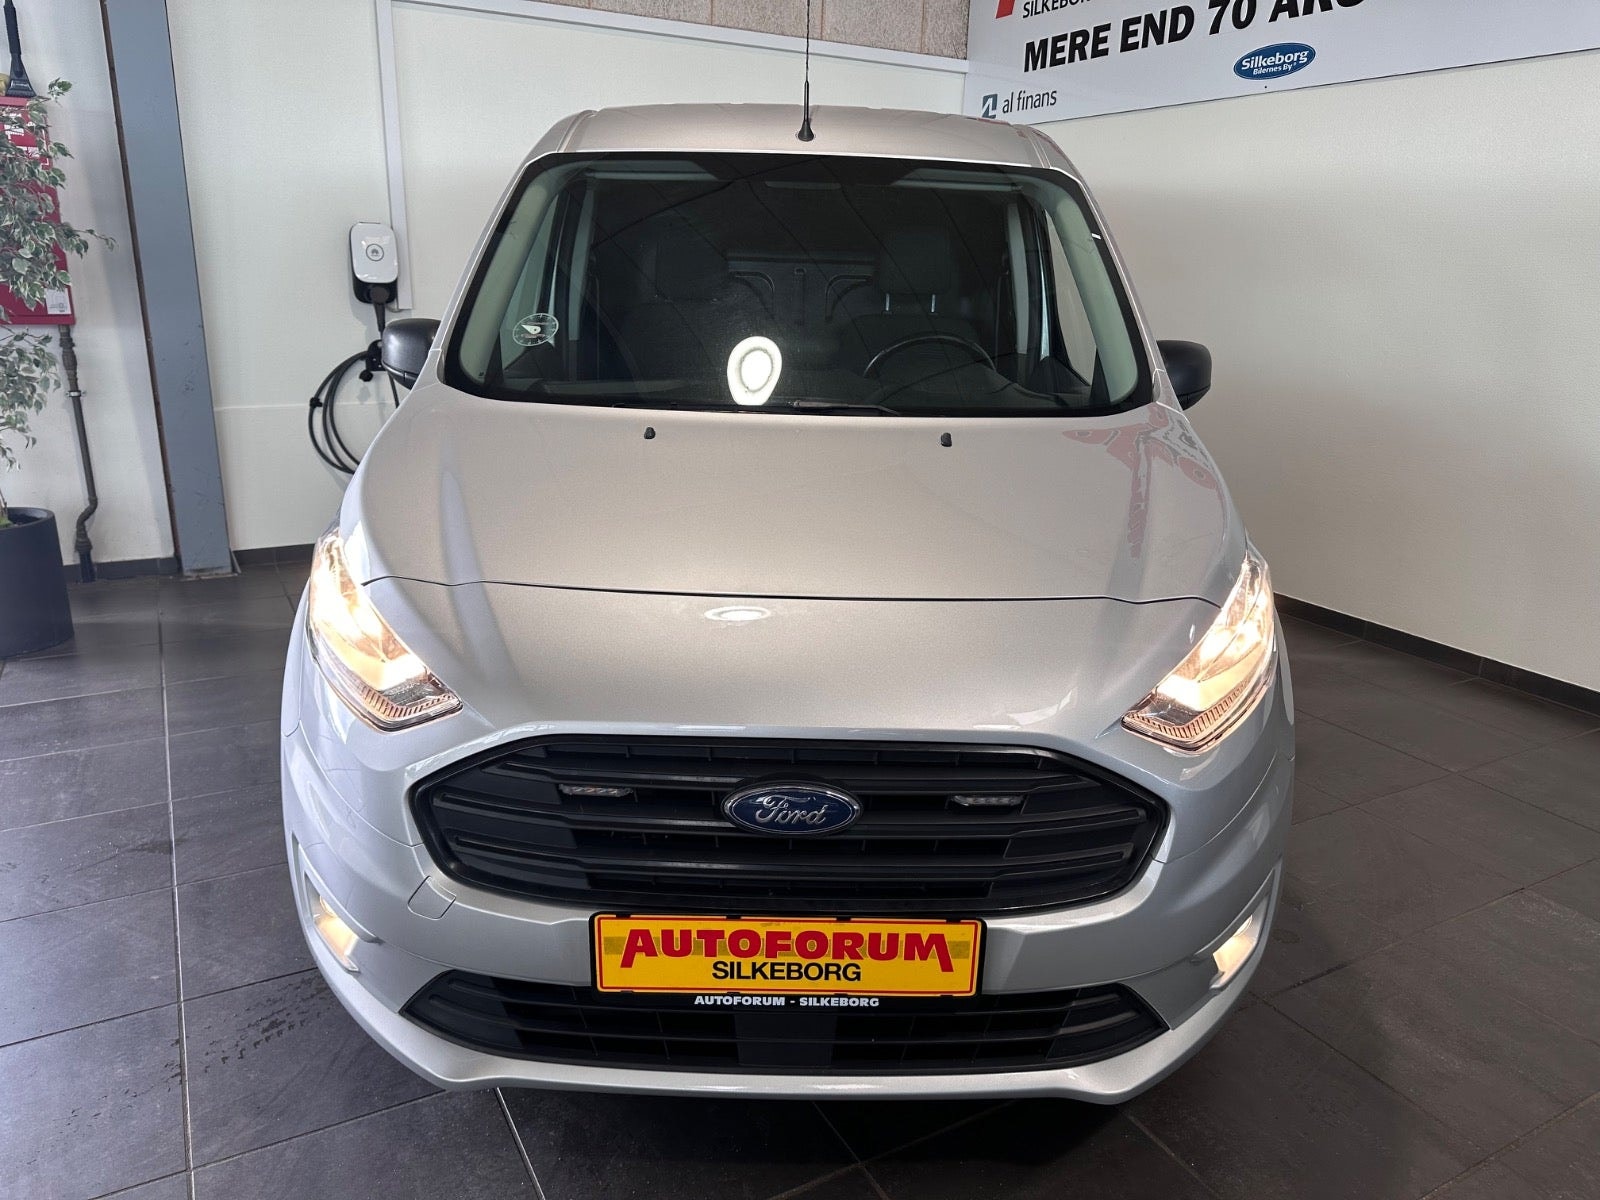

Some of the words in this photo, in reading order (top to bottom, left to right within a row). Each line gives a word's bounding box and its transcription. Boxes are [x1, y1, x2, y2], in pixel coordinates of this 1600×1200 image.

[1024, 23, 1112, 73] MERE
[1120, 5, 1195, 53] END
[1208, 0, 1257, 35] 70
[1241, 51, 1309, 70] Silkeborg
[1253, 65, 1282, 75] Bilernes
[1002, 91, 1014, 114] al
[1017, 90, 1057, 111] finans
[755, 794, 829, 824] Ford
[620, 929, 954, 973] AUTOFORUM
[712, 960, 862, 982] SILKEBORG
[694, 995, 786, 1006] AUTOFORUM
[799, 996, 880, 1007] SILKEBORG
